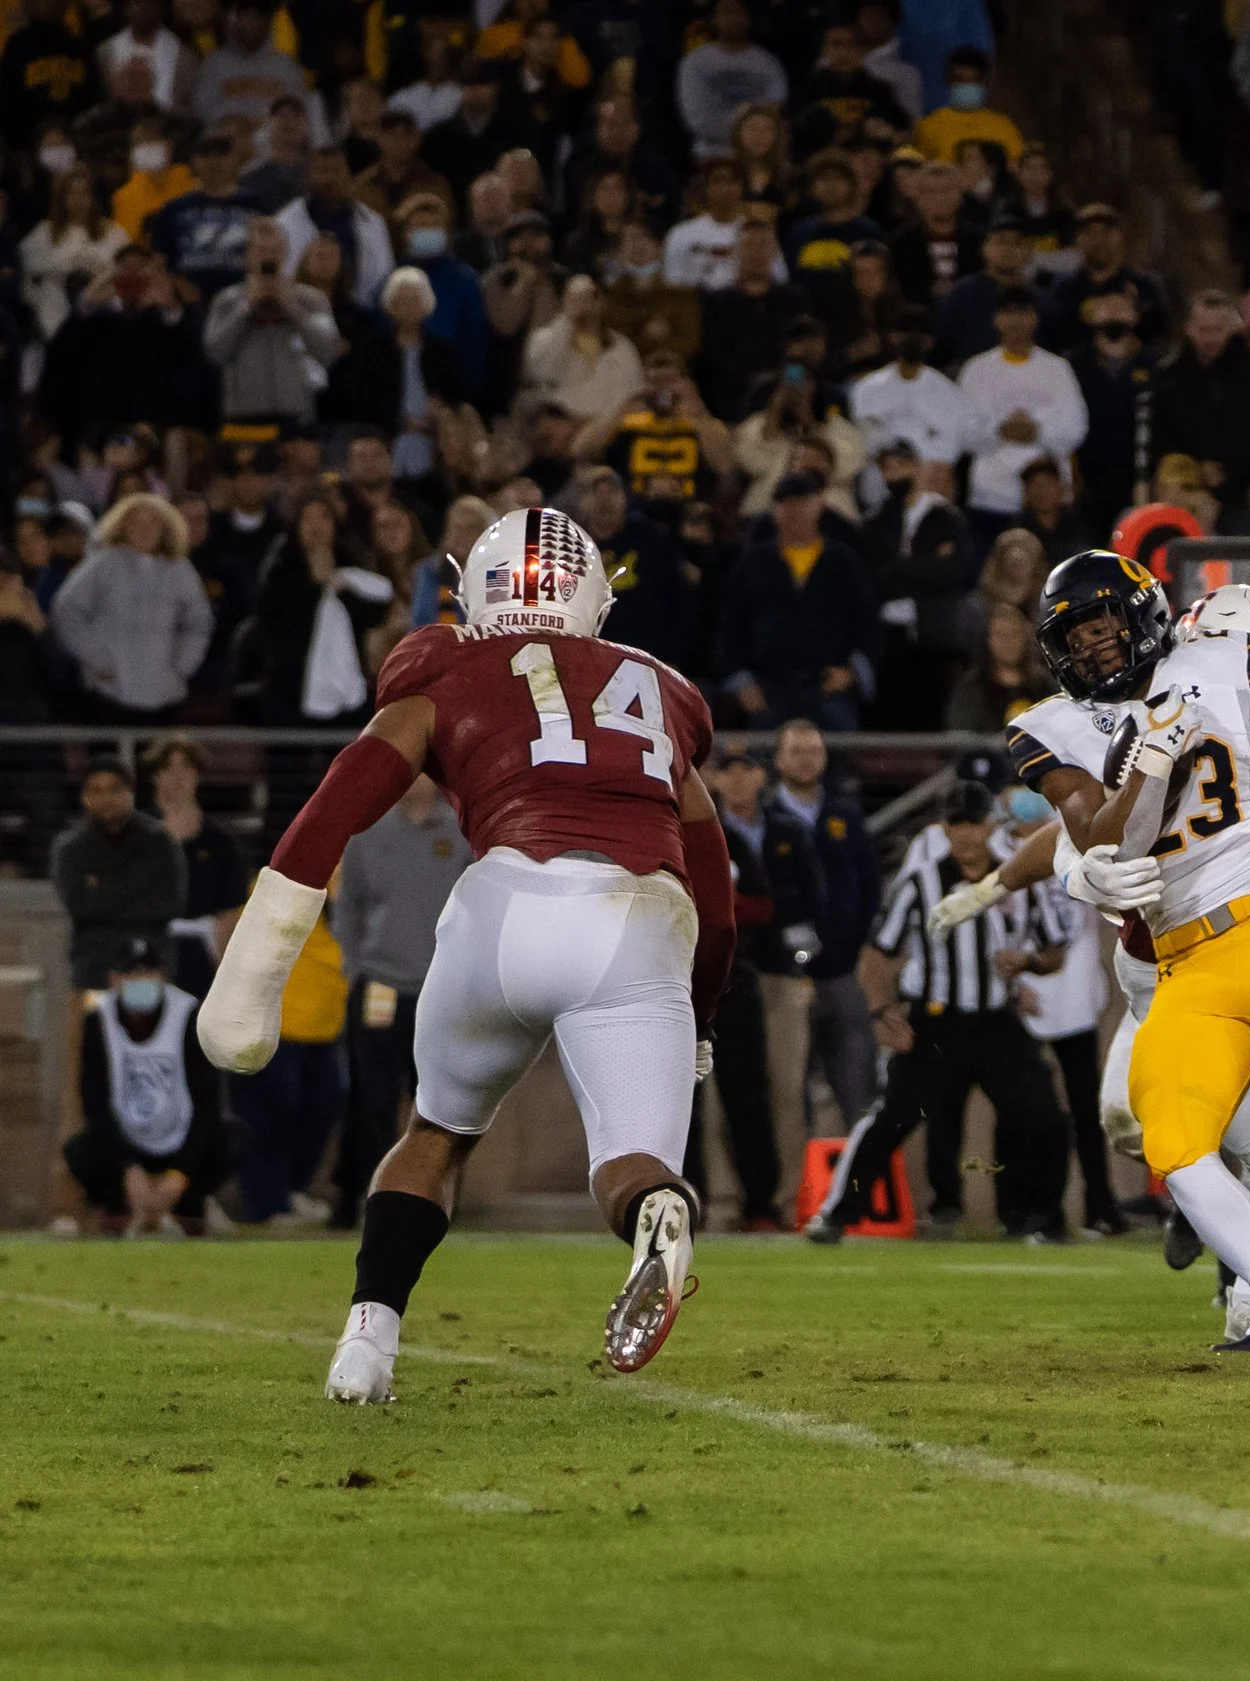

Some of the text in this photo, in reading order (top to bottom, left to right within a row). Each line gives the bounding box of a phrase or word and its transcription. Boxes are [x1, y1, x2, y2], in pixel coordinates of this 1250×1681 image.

[497, 612, 565, 630] STANFORD
[510, 642, 674, 793] 14
[1147, 733, 1245, 860] 3
